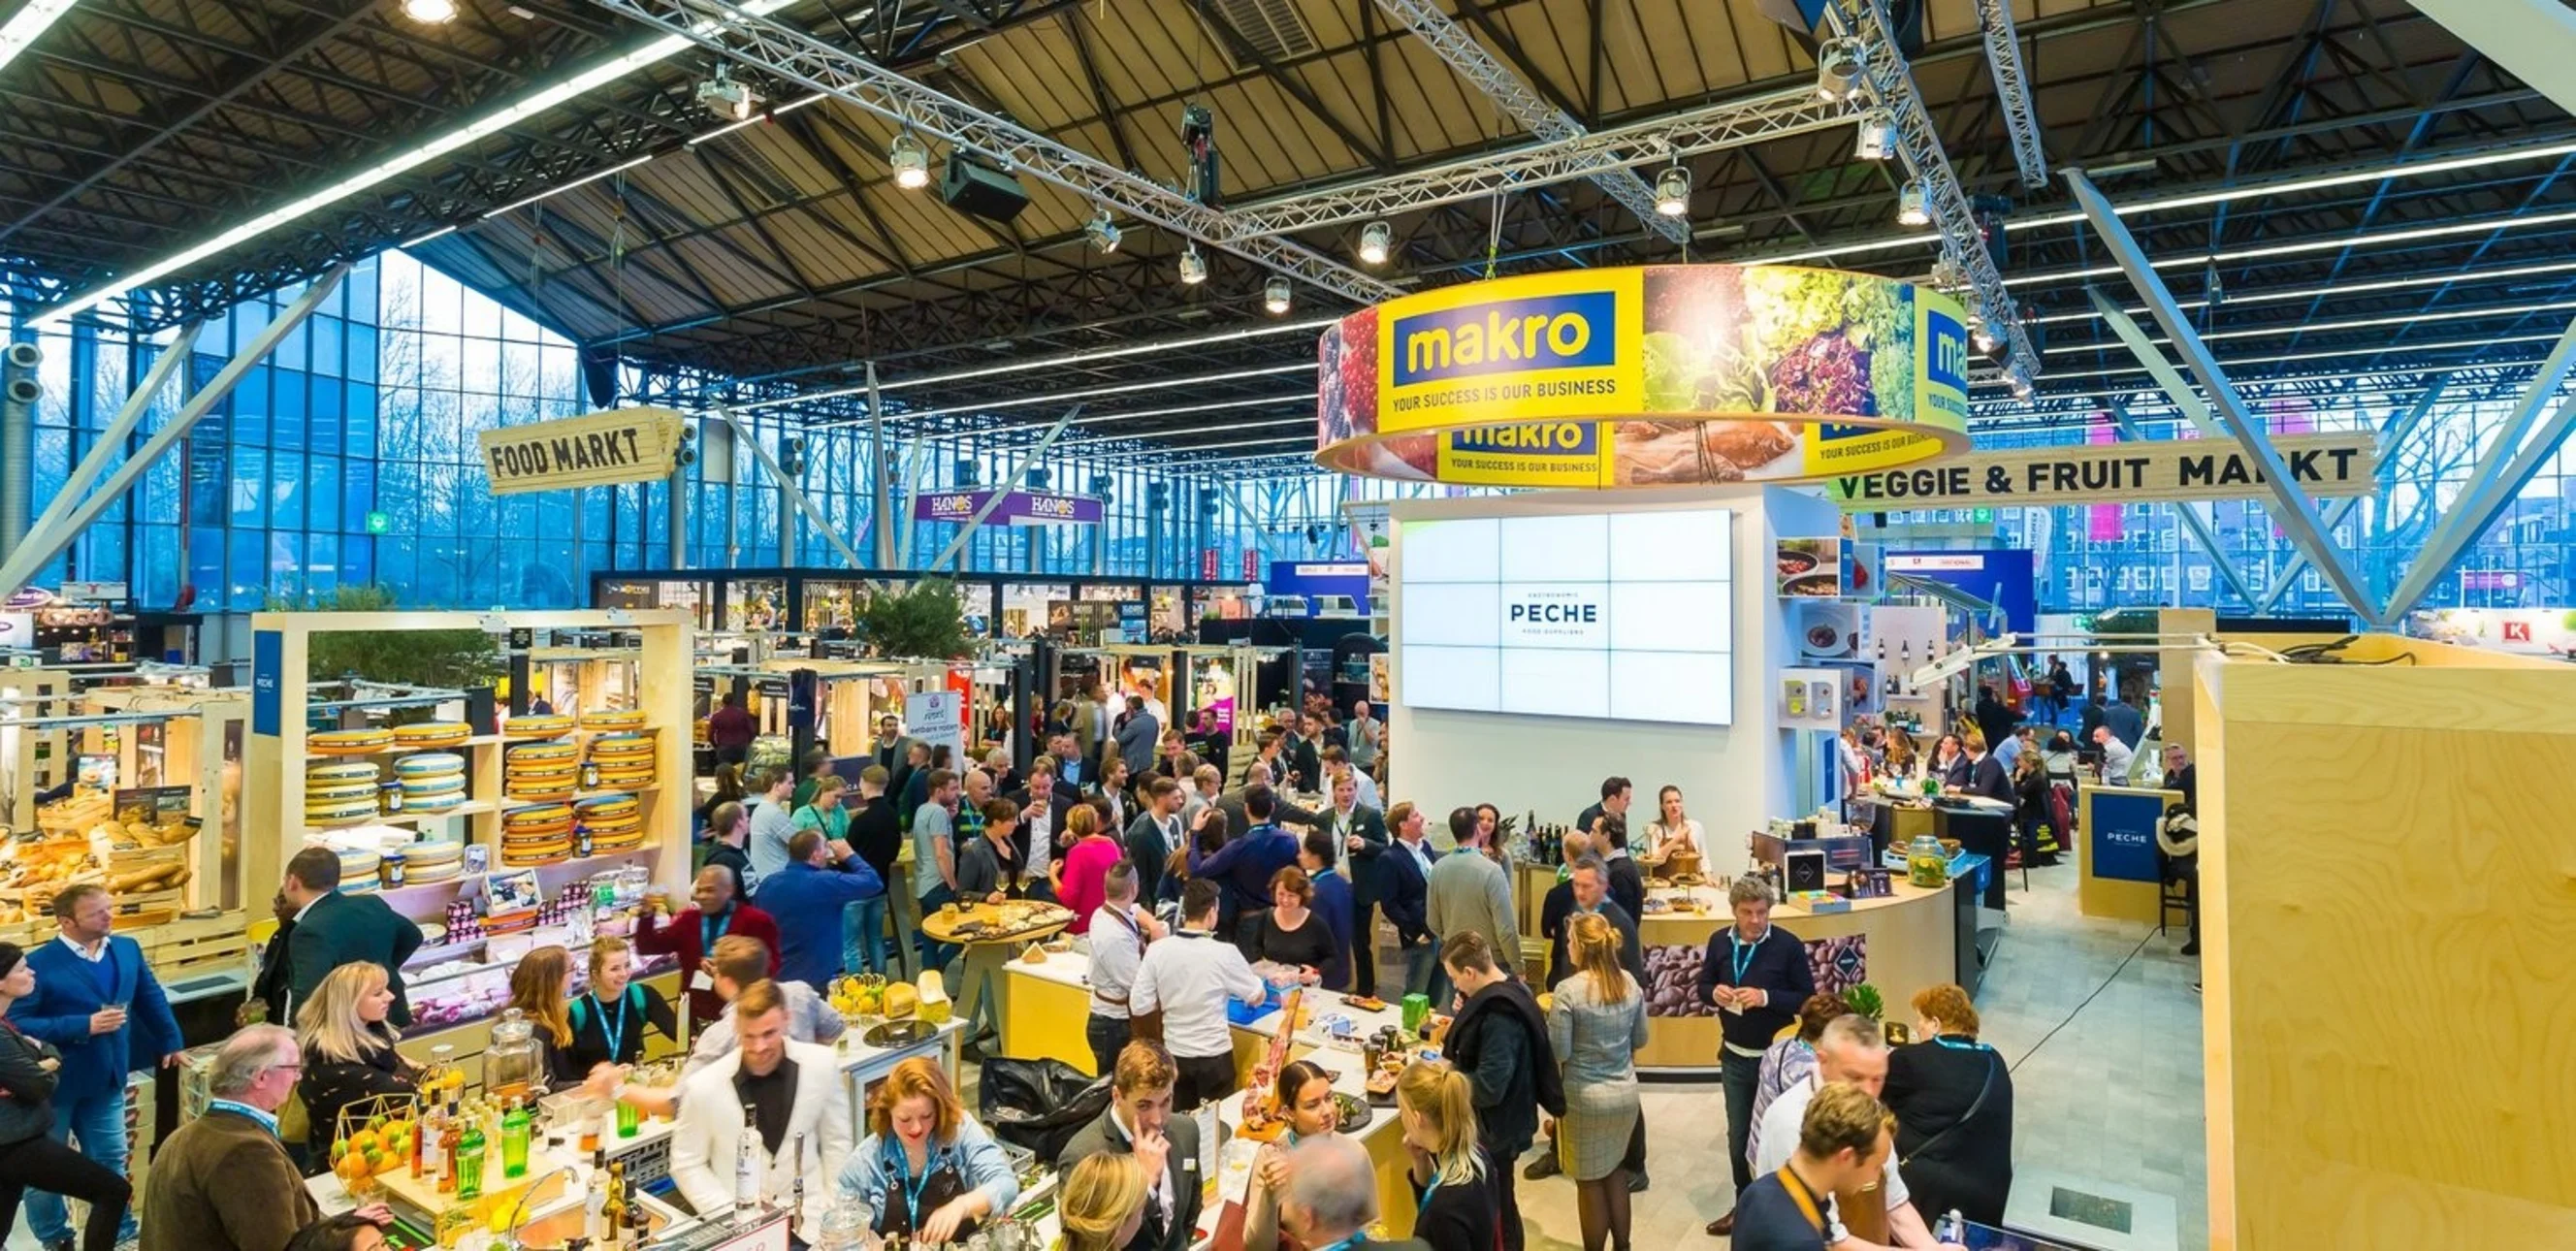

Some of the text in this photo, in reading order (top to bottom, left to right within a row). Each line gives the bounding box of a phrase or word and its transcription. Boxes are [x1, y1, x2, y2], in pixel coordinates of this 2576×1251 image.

[1408, 310, 1591, 373] makro
[1393, 379, 1616, 412] YOUR SUCCESS IS OUR BUSINESS
[1463, 422, 1582, 449] makro
[1819, 449, 1844, 460] YOUR
[1846, 441, 1882, 457] SUCCESS
[1883, 439, 1890, 451] IS
[1891, 436, 1906, 450] OUR
[490, 428, 639, 478] FOOD MARKT
[1452, 459, 1597, 472] YOUR SUCCESS IS OUR BUSINESS
[1840, 467, 1971, 499] VEGGIE
[1985, 465, 2012, 494] &
[2028, 458, 2150, 492] FRUIT
[1511, 604, 1596, 623] PECHE
[2107, 832, 2147, 844] PECHE
